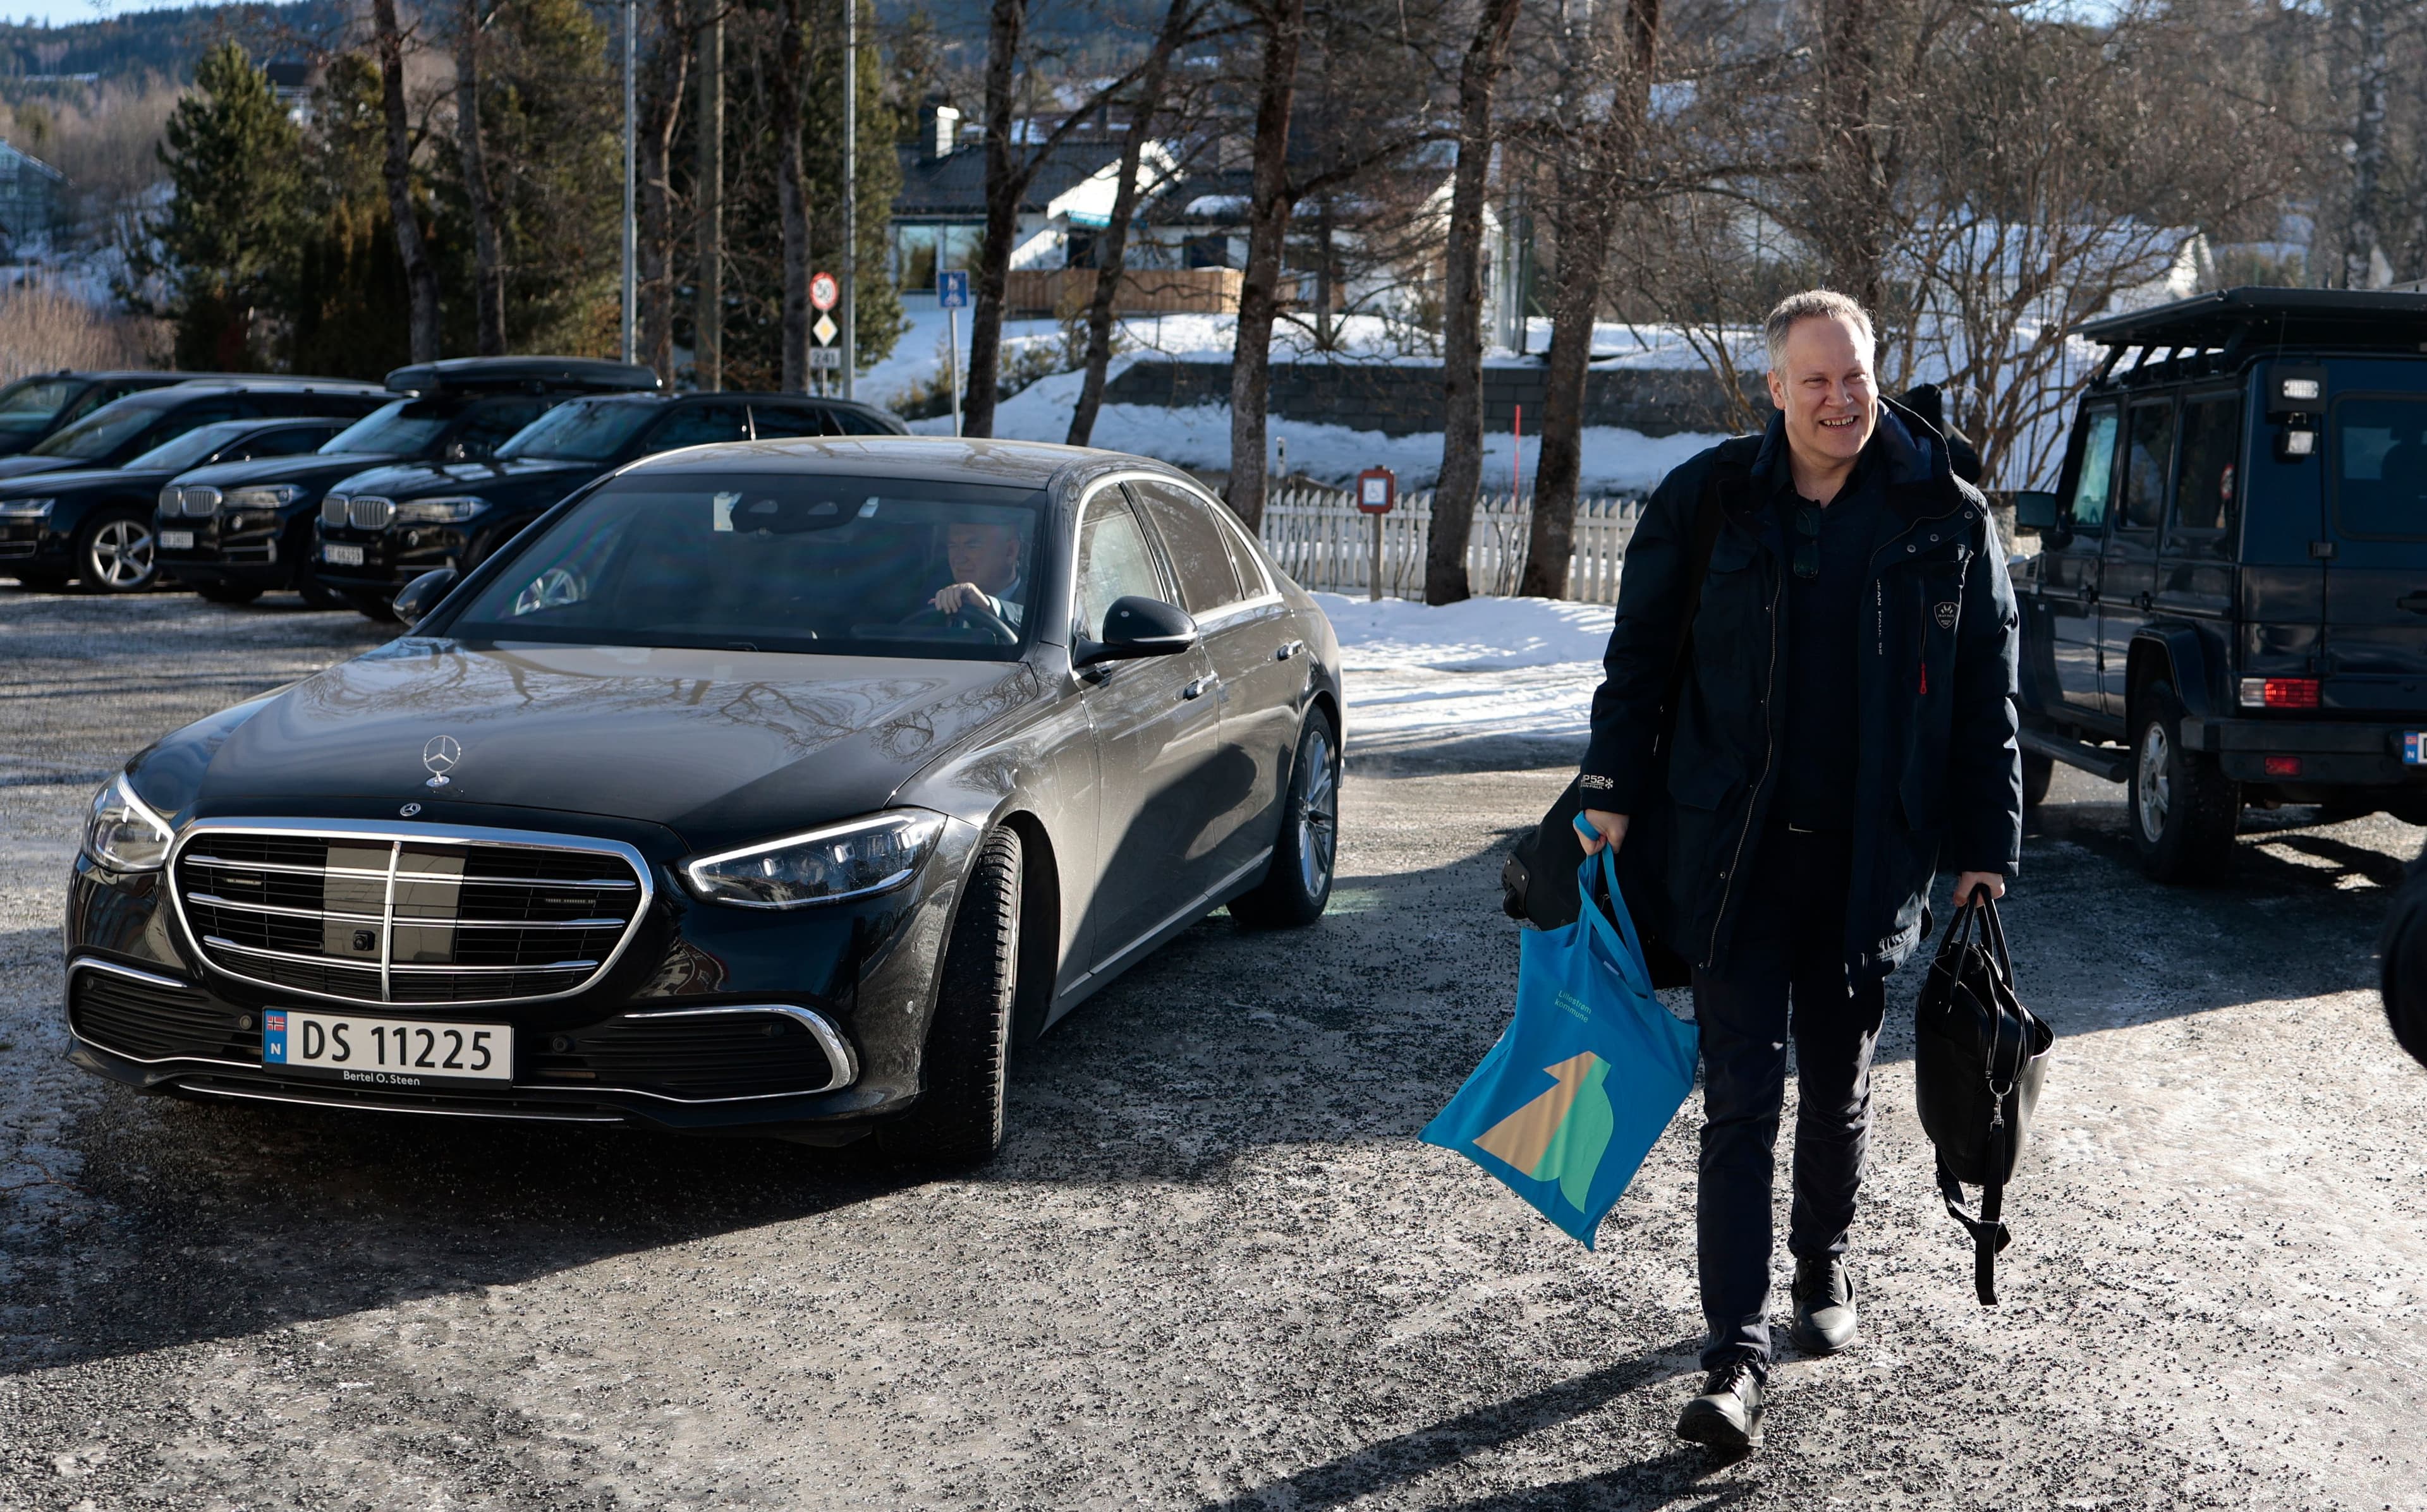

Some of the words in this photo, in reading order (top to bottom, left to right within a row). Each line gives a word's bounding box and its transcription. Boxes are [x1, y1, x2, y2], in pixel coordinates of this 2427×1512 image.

[812, 351, 836, 365] 241
[1554, 998, 1588, 1023] kommune
[1559, 990, 1592, 1014] Lillestrøm
[271, 1043, 281, 1055] N
[303, 1020, 350, 1062] DS
[371, 1026, 491, 1071] 11225
[343, 1070, 374, 1082] Bertel
[376, 1073, 389, 1084] O.
[390, 1074, 420, 1086] Steen
